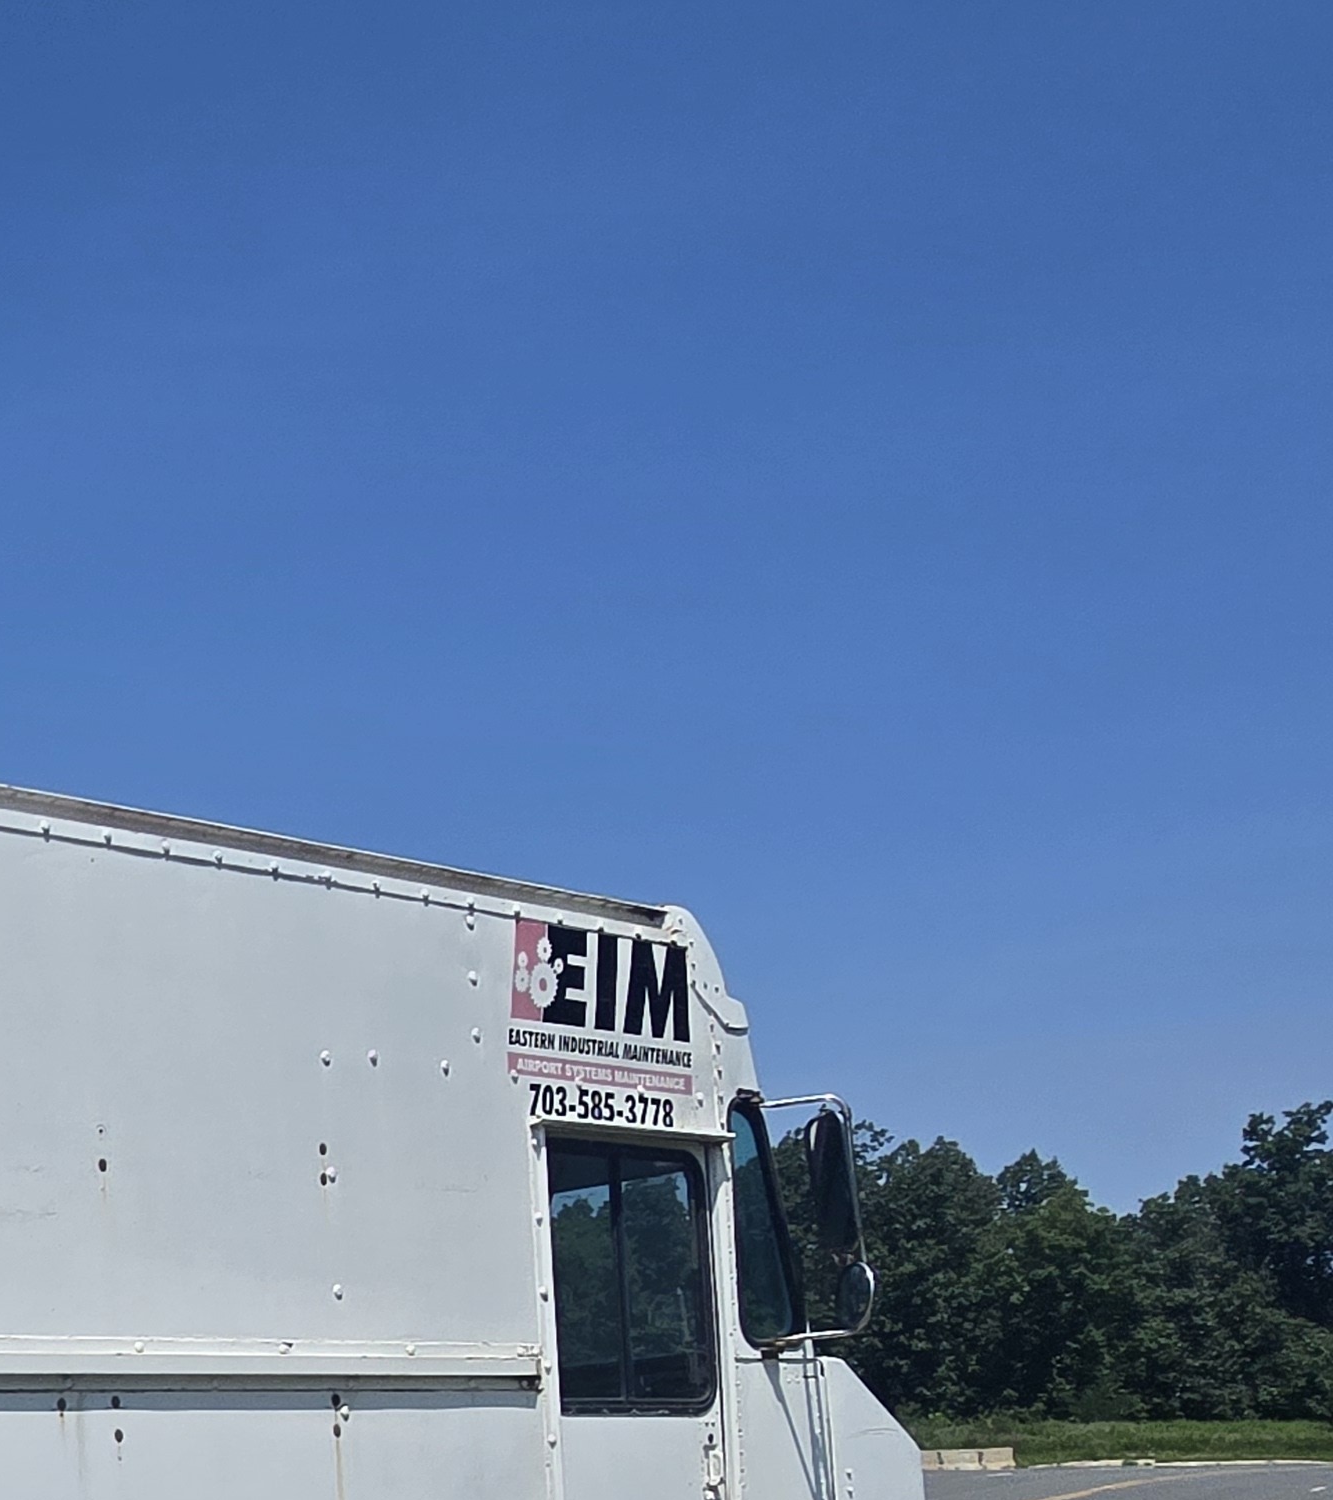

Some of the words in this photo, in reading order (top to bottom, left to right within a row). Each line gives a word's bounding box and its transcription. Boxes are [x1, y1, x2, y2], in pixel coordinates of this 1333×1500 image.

[542, 925, 691, 1043] EIM
[508, 1028, 556, 1051] EASTERN
[558, 1034, 620, 1059] INDUSTRIAL
[622, 1043, 693, 1068] MAINTENANCE
[516, 1058, 563, 1076] AIRPORT
[565, 1064, 613, 1082] SYSTEMS
[614, 1070, 686, 1090] MAINTENANCE
[529, 1083, 674, 1128] 703-585-3778
